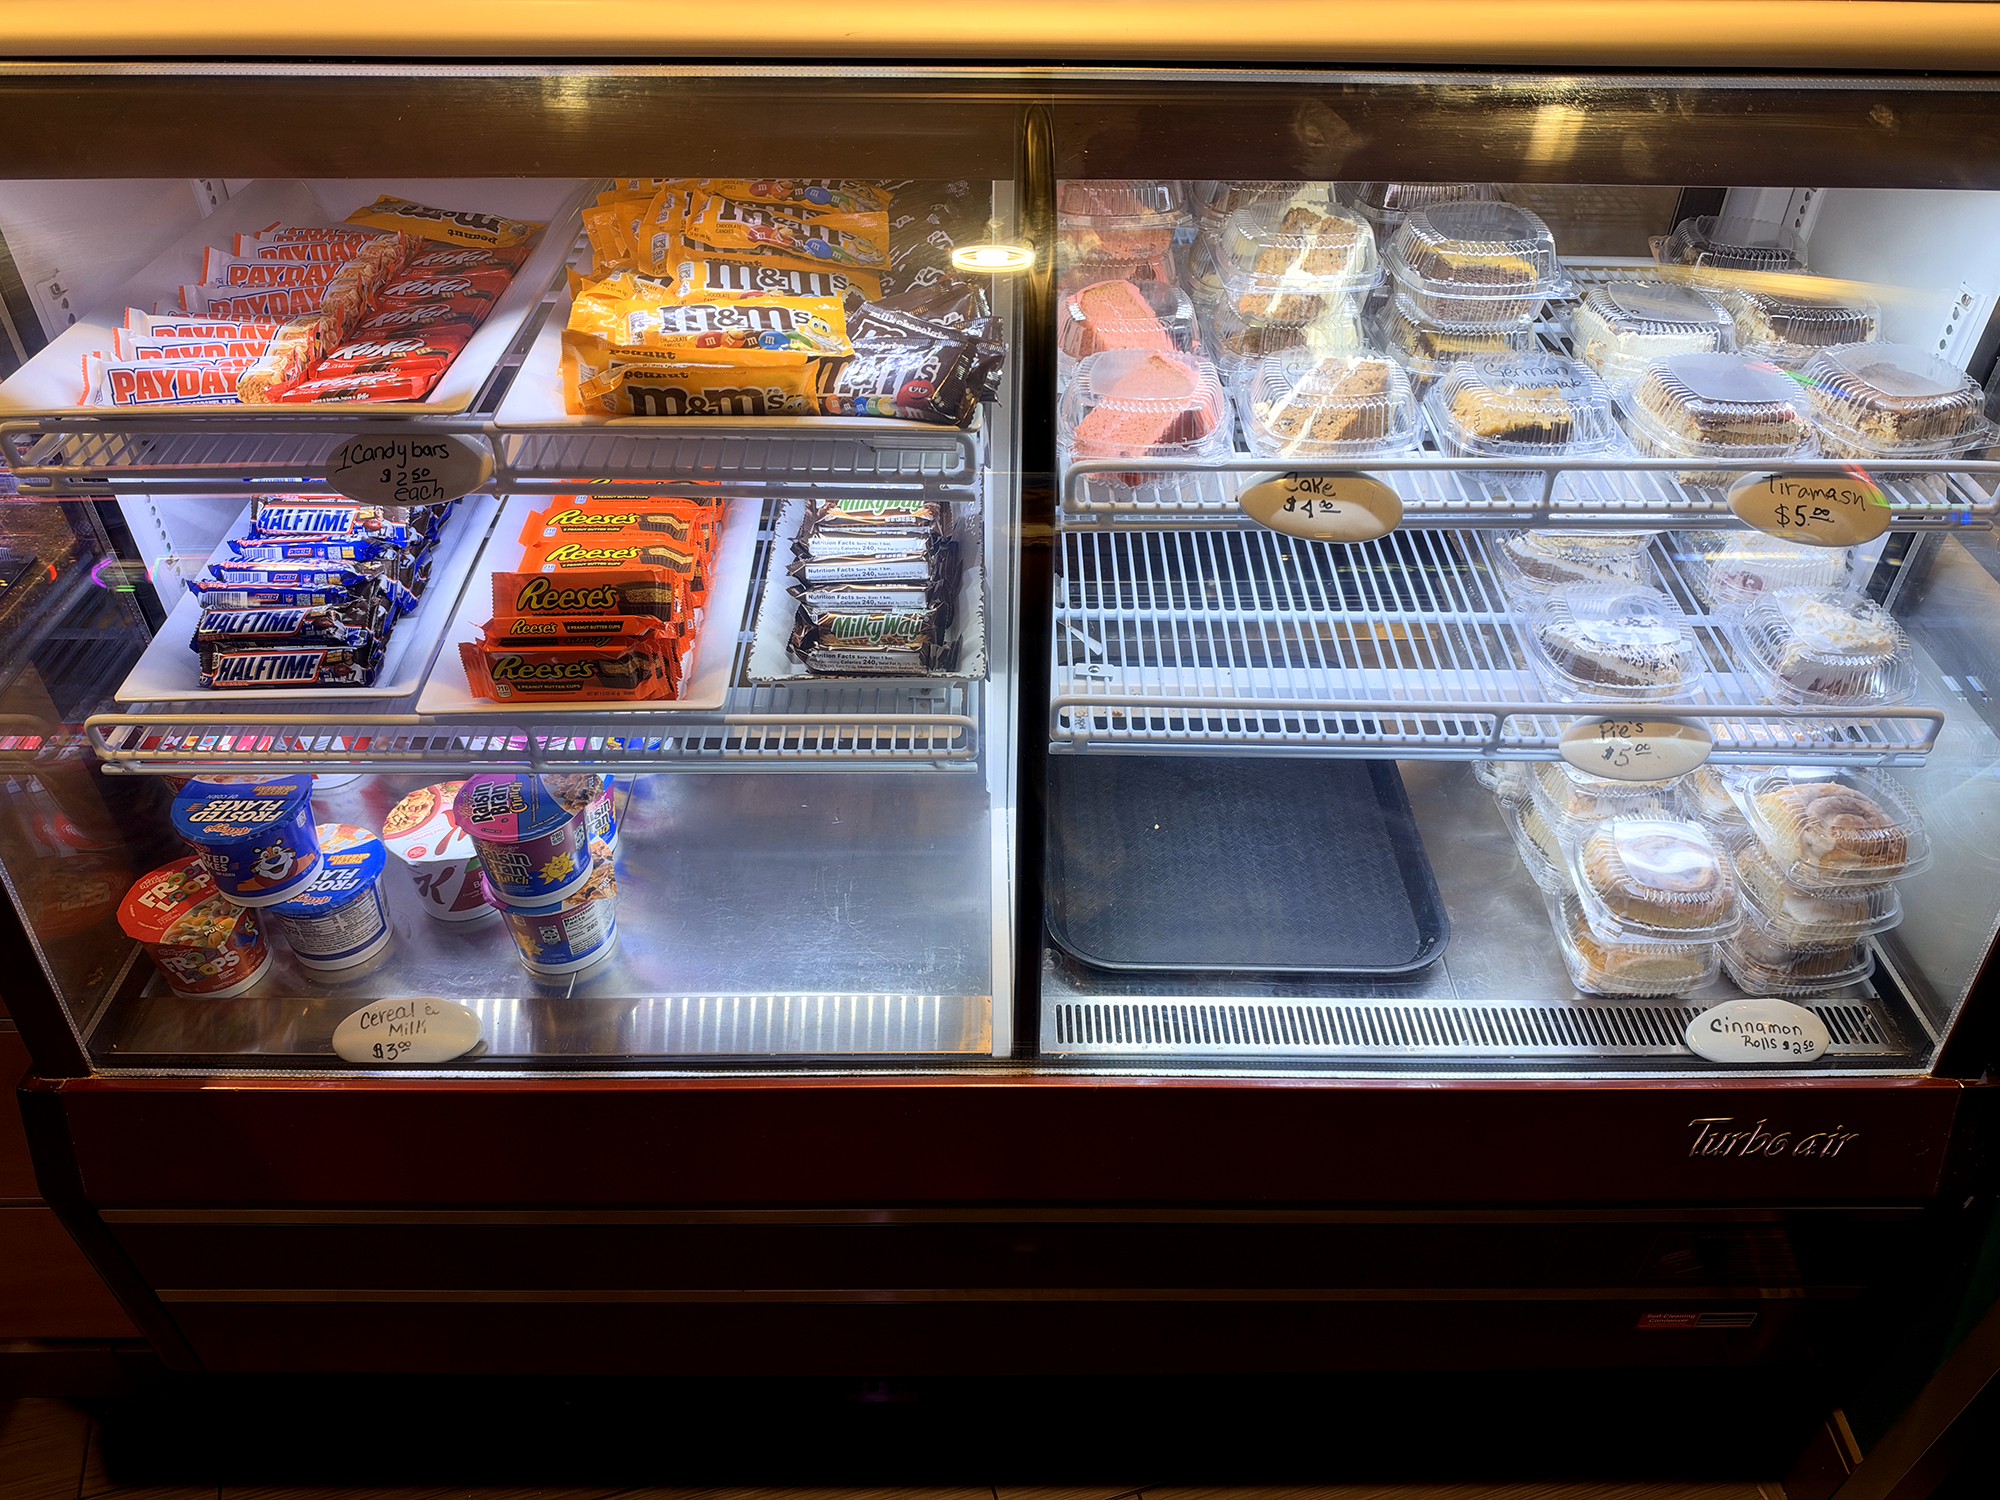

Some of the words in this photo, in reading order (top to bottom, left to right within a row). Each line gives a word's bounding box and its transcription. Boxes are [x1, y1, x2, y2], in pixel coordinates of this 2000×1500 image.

[229, 263, 342, 285] PAYDAY
[609, 348, 676, 360] peanut
[623, 370, 689, 379] peanut
[1483, 362, 1569, 378] German
[112, 368, 241, 402] PAYDAY
[627, 385, 785, 416] m&m's
[351, 440, 407, 468] Candy
[411, 440, 450, 459] bars
[394, 479, 445, 501] each
[258, 508, 351, 532] HALFTIME
[547, 509, 641, 526] Reese's
[545, 543, 641, 562] Reese's
[516, 576, 619, 612] Reese's
[200, 609, 304, 634] HALFTIME
[510, 618, 558, 635] Reese's
[218, 654, 320, 682] HALFTIME
[491, 654, 596, 682] Reese's
[203, 800, 286, 812] FLAKES
[470, 781, 494, 824] Raisin
[490, 782, 510, 817] Bran
[510, 781, 529, 814] Crunch
[188, 810, 284, 823] FROSTED
[320, 868, 361, 880] FLA
[155, 873, 212, 913] LOOP
[306, 879, 360, 892] FROS
[203, 924, 225, 938] PULL
[360, 1002, 415, 1030] Cereal
[1709, 1016, 1803, 1036] Cinnamon
[1741, 1035, 1778, 1051] Rolls
[1687, 1116, 1792, 1158] Turbo
[1791, 1124, 1860, 1158] air
